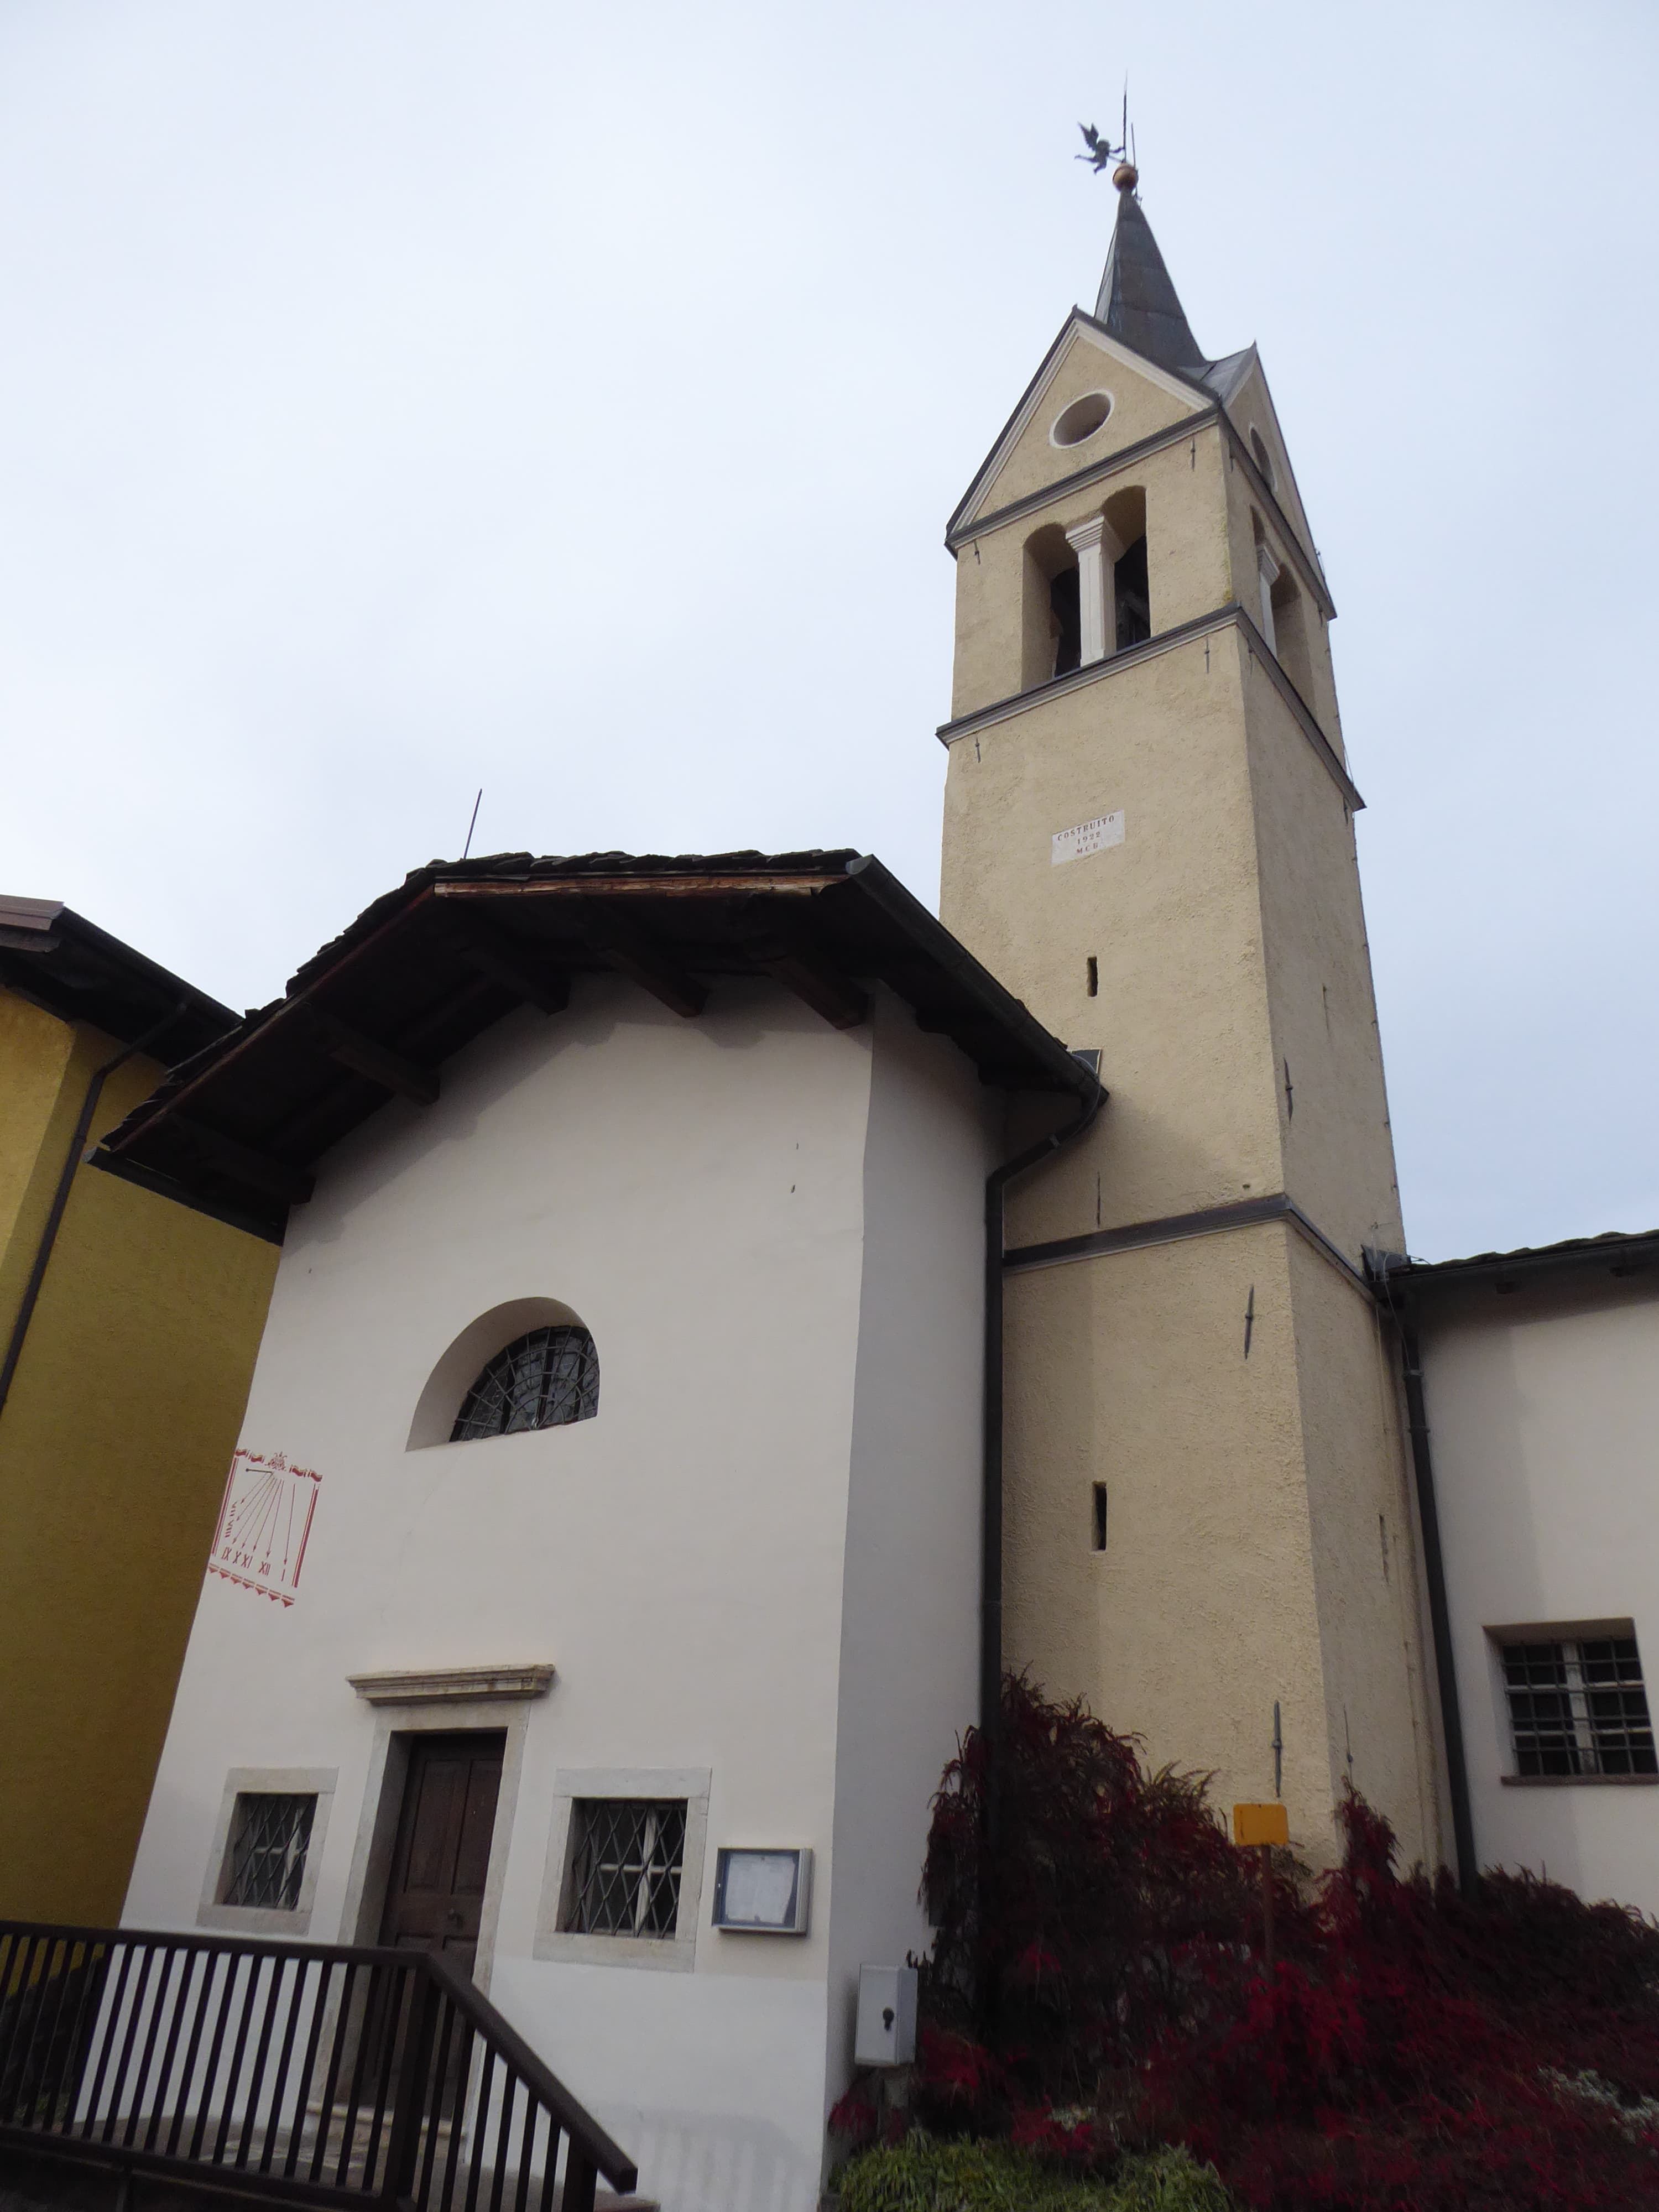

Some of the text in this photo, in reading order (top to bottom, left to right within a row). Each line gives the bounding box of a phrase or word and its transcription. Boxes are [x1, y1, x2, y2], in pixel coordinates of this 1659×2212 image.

[1057, 815, 1114, 841] COSTRUITO
[1077, 832, 1100, 844] 1922
[221, 1547, 232, 1561] IX
[241, 1554, 253, 1568] XI
[258, 1561, 271, 1576] XII
